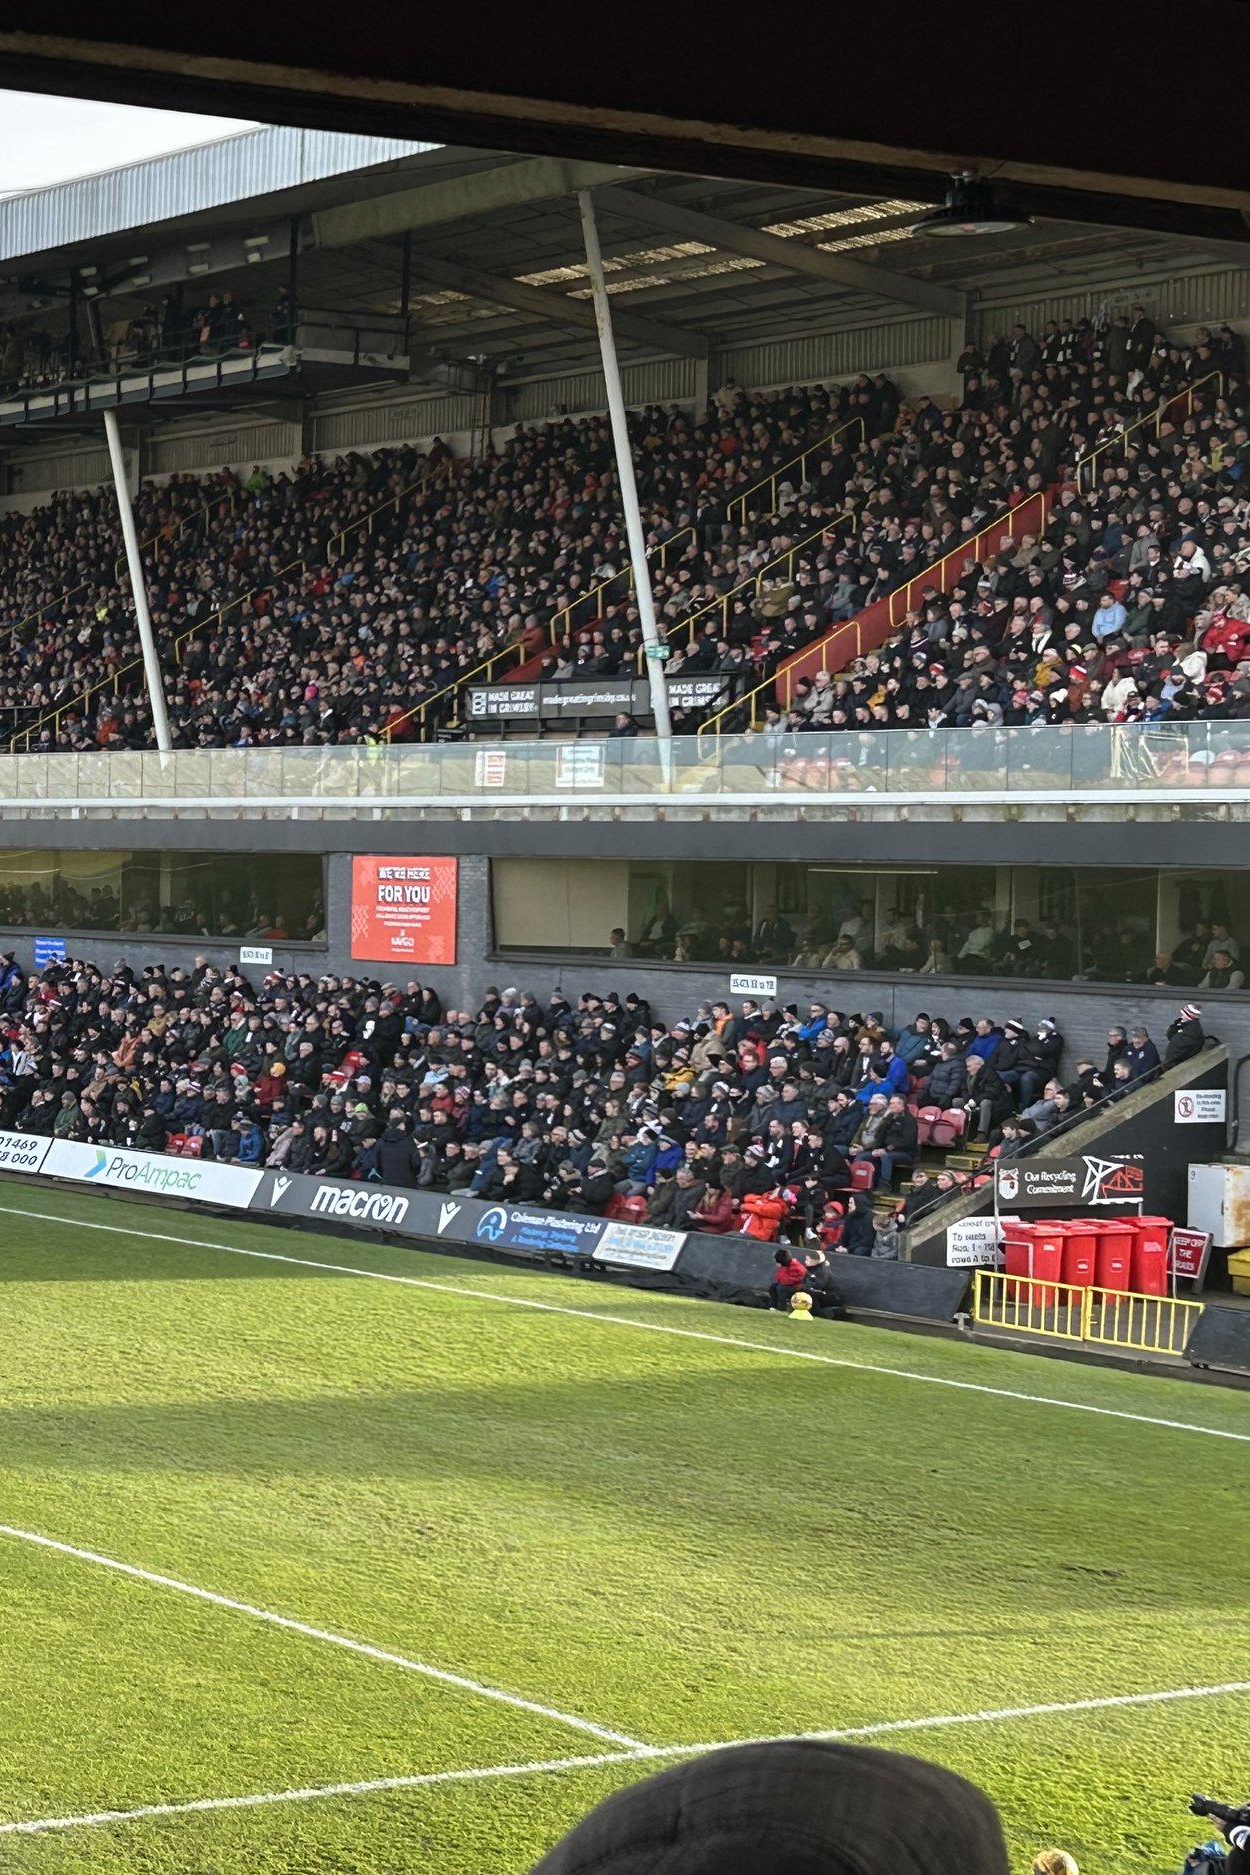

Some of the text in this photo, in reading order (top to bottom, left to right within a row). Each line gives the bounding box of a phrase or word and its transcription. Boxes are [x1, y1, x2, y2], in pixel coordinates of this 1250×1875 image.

[669, 683, 694, 694] MADE
[488, 690, 535, 702] MADE GREAT
[669, 697, 680, 707] IN
[488, 703, 497, 713] IN
[378, 885, 431, 904] FOR YOU
[10, 1152, 38, 1166] 000
[105, 1156, 202, 1190] ProAmpac
[1024, 1170, 1077, 1183] Our Recycling
[1026, 1184, 1075, 1195] Commitment
[310, 1185, 410, 1224] macron
[584, 1222, 602, 1234] Ltd
[952, 1232, 963, 1241] To
[1179, 1248, 1194, 1260] THE
